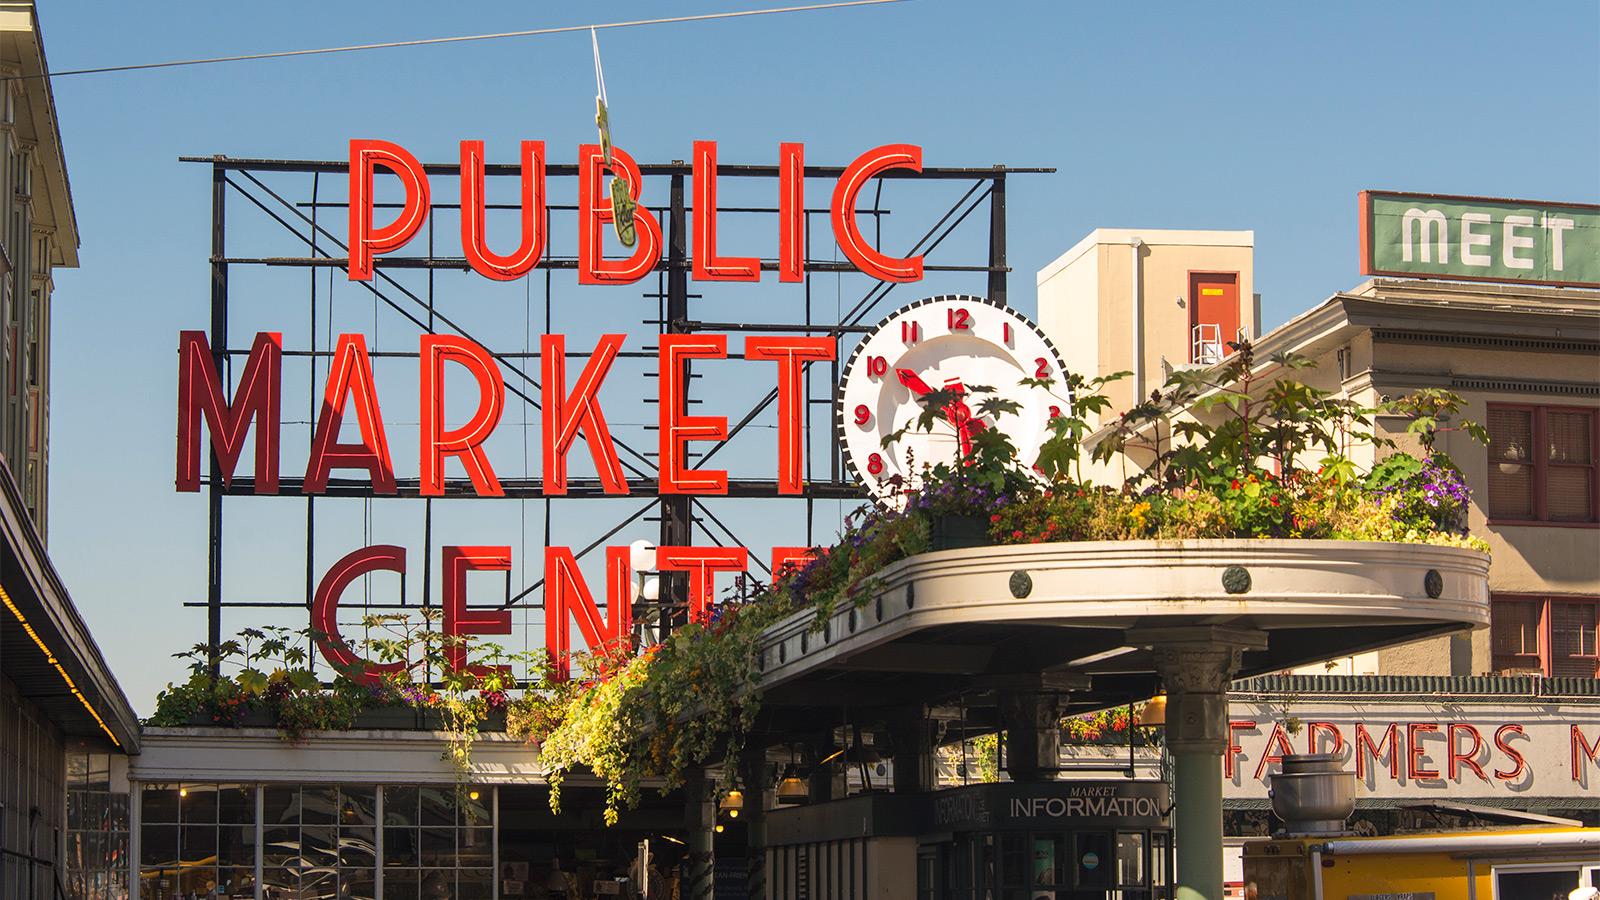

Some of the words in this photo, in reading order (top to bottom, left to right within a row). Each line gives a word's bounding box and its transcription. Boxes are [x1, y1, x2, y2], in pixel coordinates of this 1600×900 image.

[348, 138, 924, 285] PUBLIC
[1401, 207, 1575, 271] MEET
[947, 308, 970, 330] 12
[901, 320, 918, 343] 11
[1003, 322, 1009, 343] 1
[866, 355, 888, 378] 10
[1035, 357, 1049, 378] 2
[174, 329, 837, 497] MARKET
[854, 404, 870, 425] 9
[867, 452, 883, 474] 8
[1070, 786, 1118, 798] MARKET
[1010, 797, 1161, 817] INFORMATION
